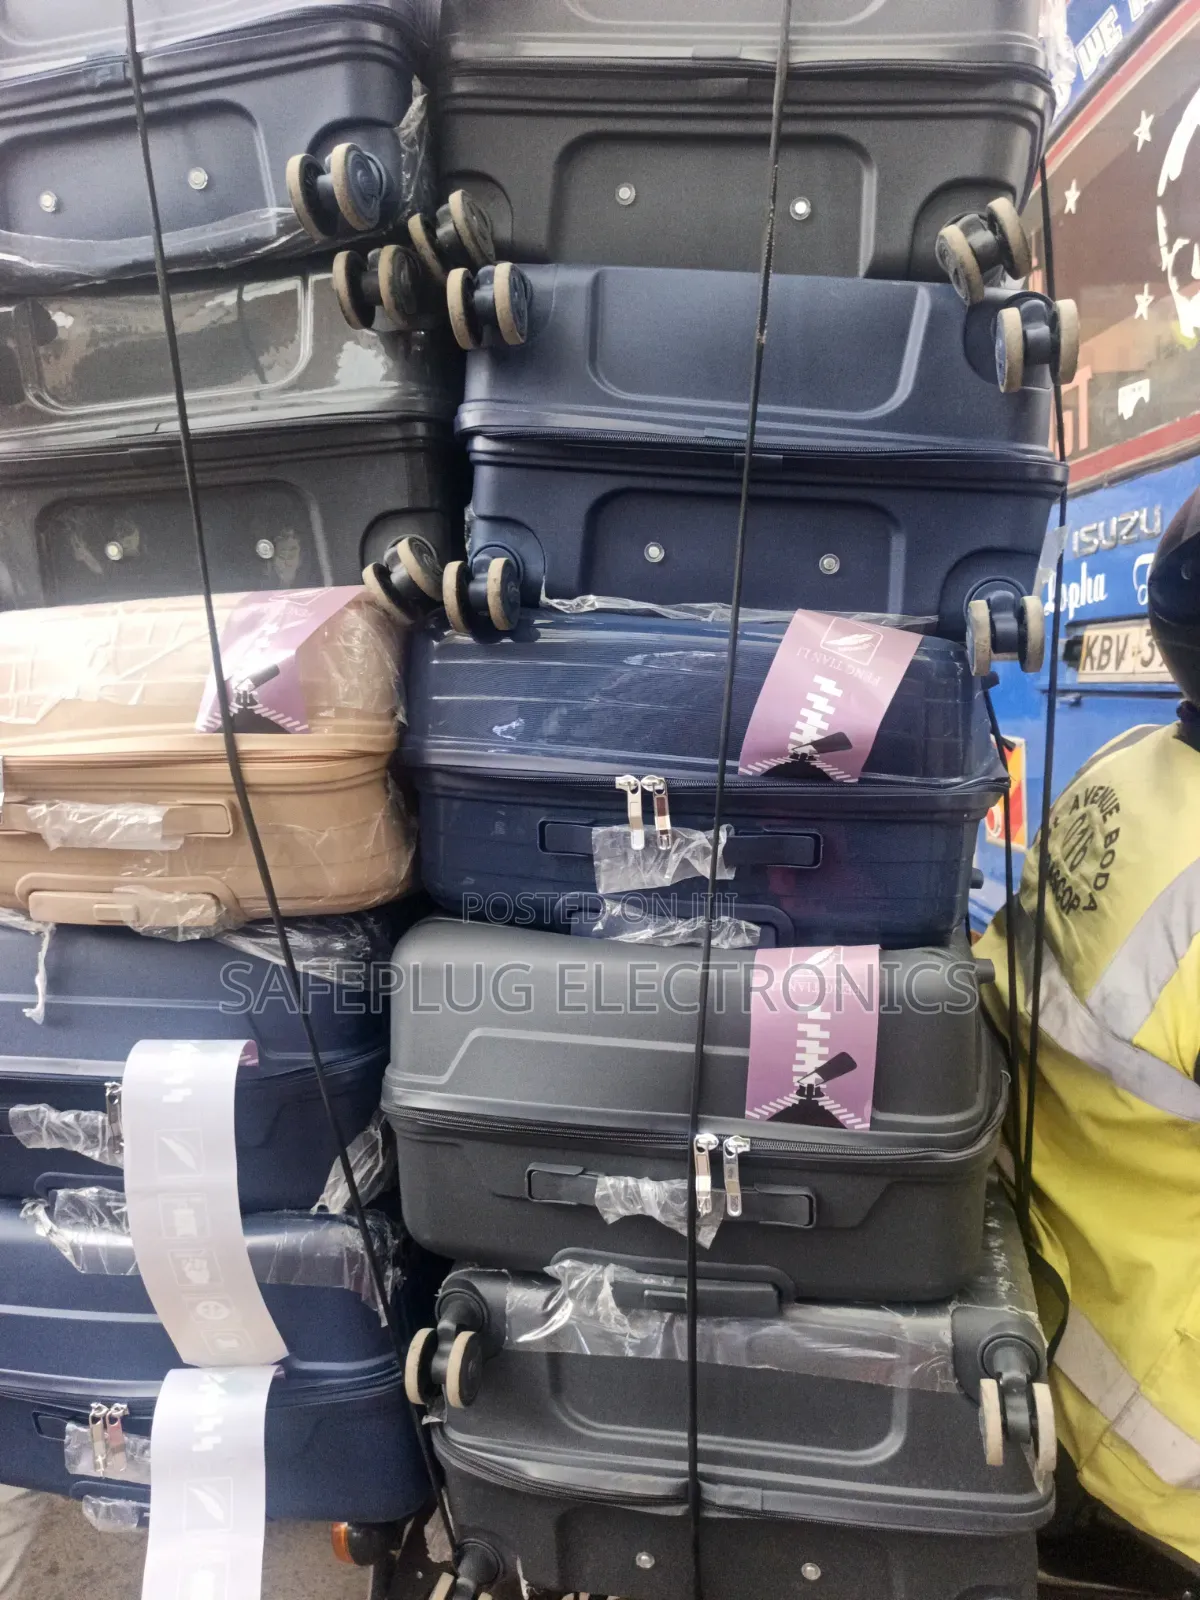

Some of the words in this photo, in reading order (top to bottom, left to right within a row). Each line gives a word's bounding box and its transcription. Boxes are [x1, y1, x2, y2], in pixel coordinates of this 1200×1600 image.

[1072, 503, 1162, 557] ISUZU
[1081, 633, 1130, 672] KBV
[1069, 785, 1121, 824] AVENUE
